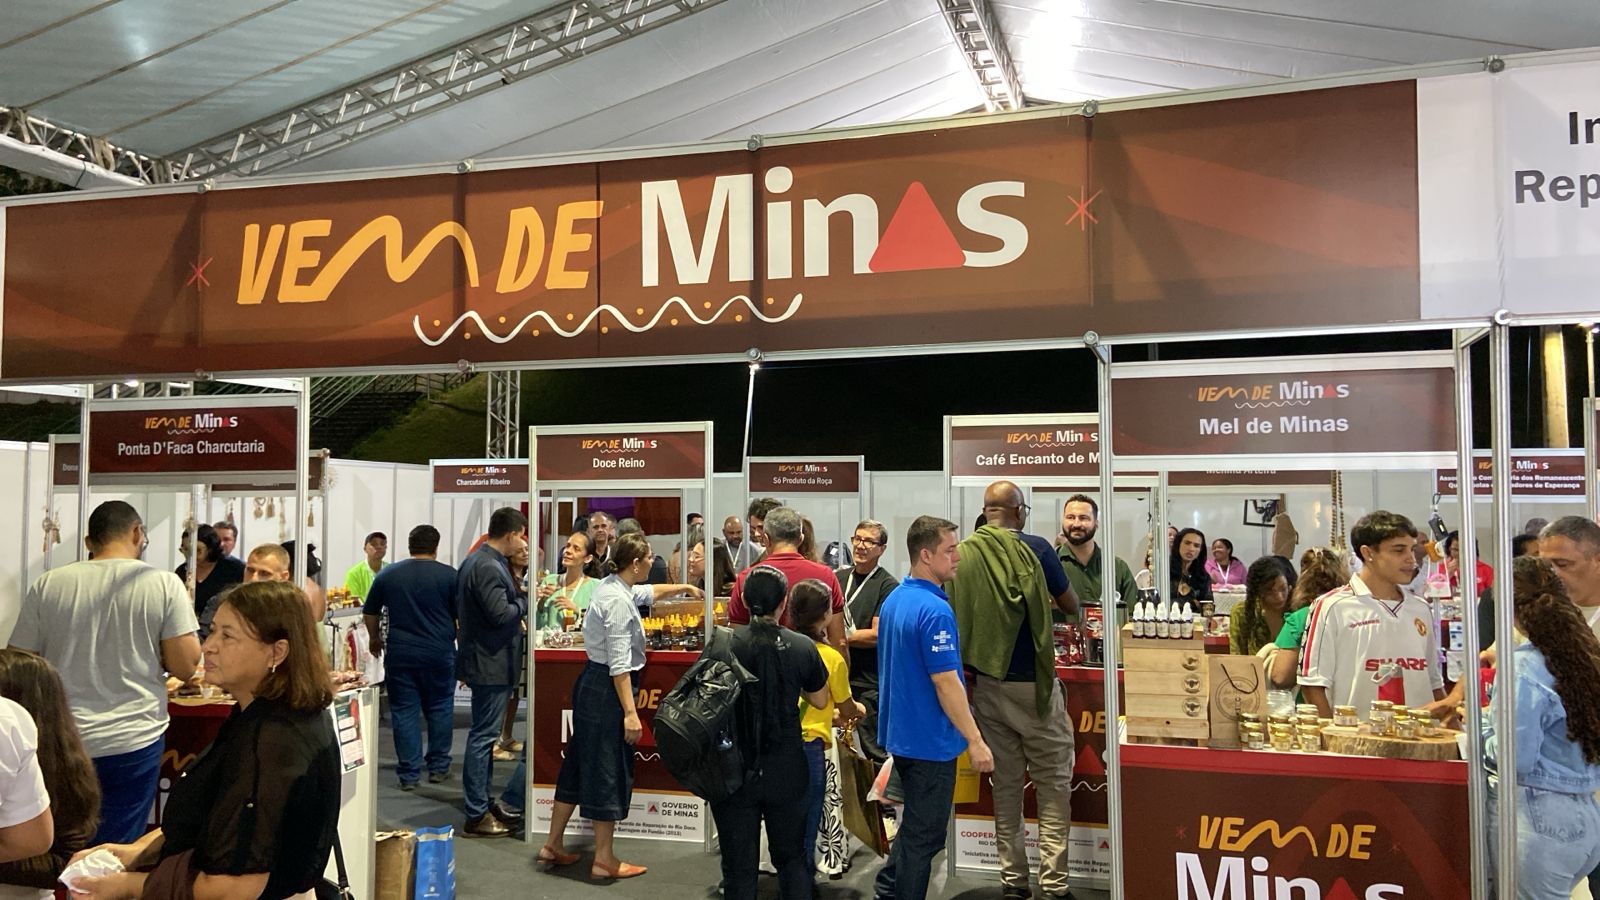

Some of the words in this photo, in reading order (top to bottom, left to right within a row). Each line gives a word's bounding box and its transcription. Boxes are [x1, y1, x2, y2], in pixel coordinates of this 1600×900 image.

[1515, 170, 1600, 208] Rep
[236, 214, 480, 306] VEM
[495, 200, 604, 294] DE
[641, 165, 1029, 287] Minas
[1252, 385, 1272, 400] DE
[1280, 380, 1350, 400] Minas
[178, 416, 192, 428] DE
[1200, 418, 1238, 434] Mel
[1246, 417, 1272, 434] de
[1280, 416, 1349, 434] Minas
[608, 440, 620, 448] DE
[1040, 432, 1052, 442] DE
[118, 442, 150, 456] Ponta
[154, 441, 194, 454] D'Faca
[196, 440, 265, 454] Charcutaria
[592, 458, 616, 468] Doce
[618, 458, 646, 468] Reino
[976, 452, 1006, 466] Café
[1010, 453, 1064, 465] Encanto
[1068, 452, 1084, 464] de
[782, 476, 806, 484] Produto
[816, 477, 832, 486] Roça
[1544, 482, 1580, 490] Esperança
[637, 688, 661, 710] DE
[1079, 710, 1105, 734] DE
[662, 802, 698, 810] GOVERNO
[1198, 815, 1318, 857] VEM
[1326, 824, 1376, 860] DE
